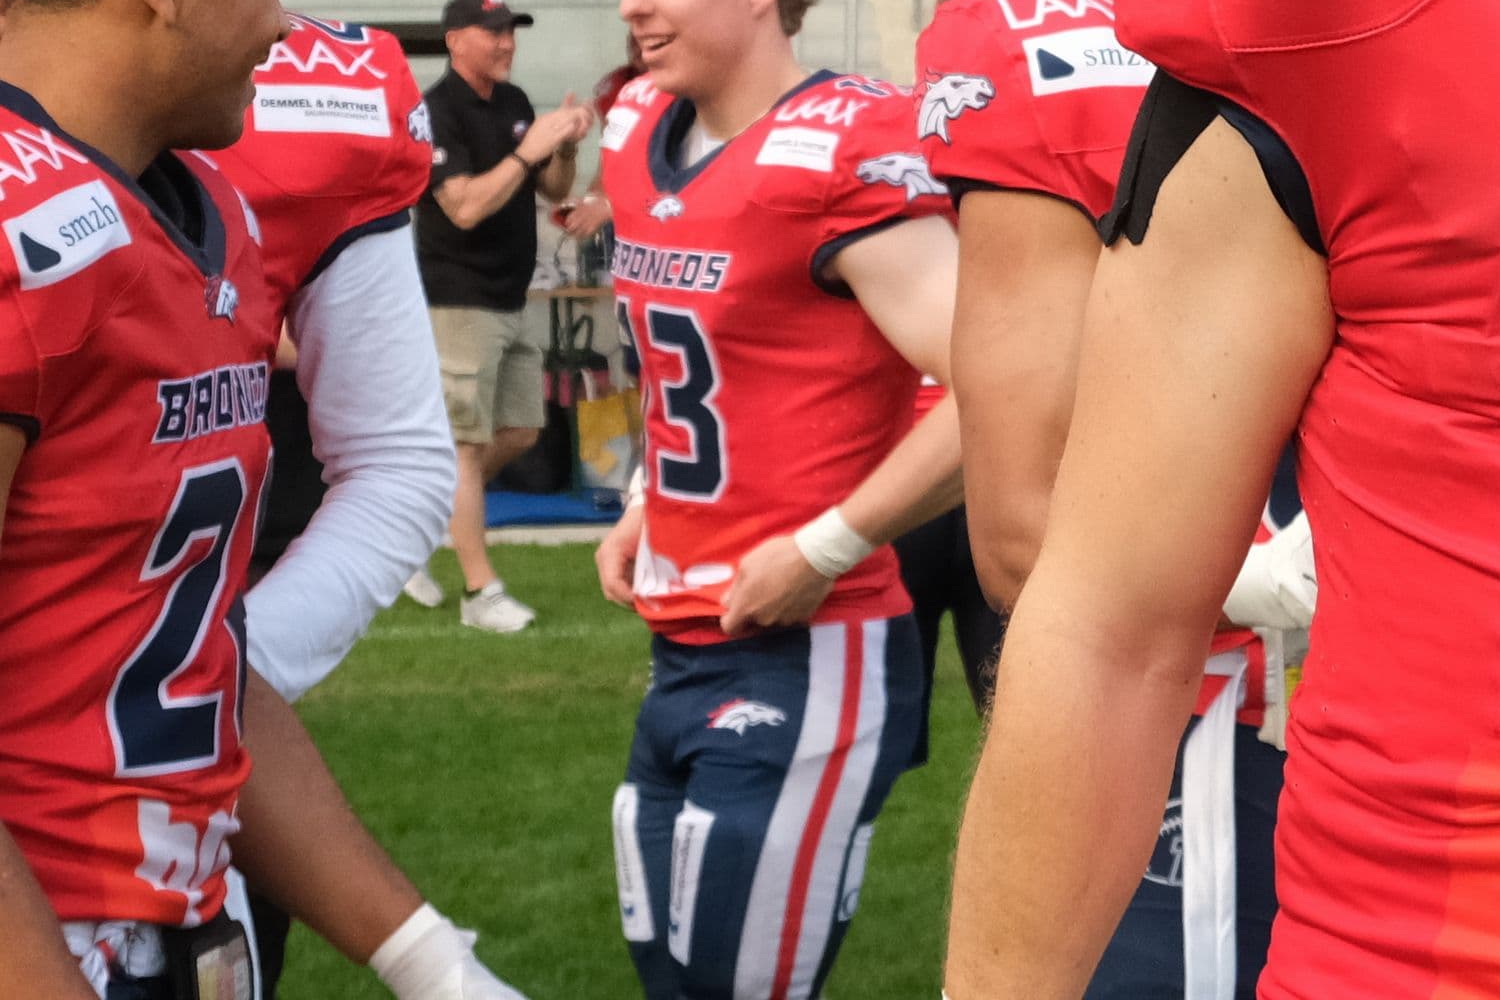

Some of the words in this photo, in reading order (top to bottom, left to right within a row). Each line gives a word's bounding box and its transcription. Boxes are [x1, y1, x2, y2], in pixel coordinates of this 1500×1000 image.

[1083, 47, 1150, 67] smz
[260, 98, 312, 109] DEMMEL
[326, 100, 378, 113] PARTNER
[58, 196, 119, 247] smzh
[614, 296, 730, 503] 3
